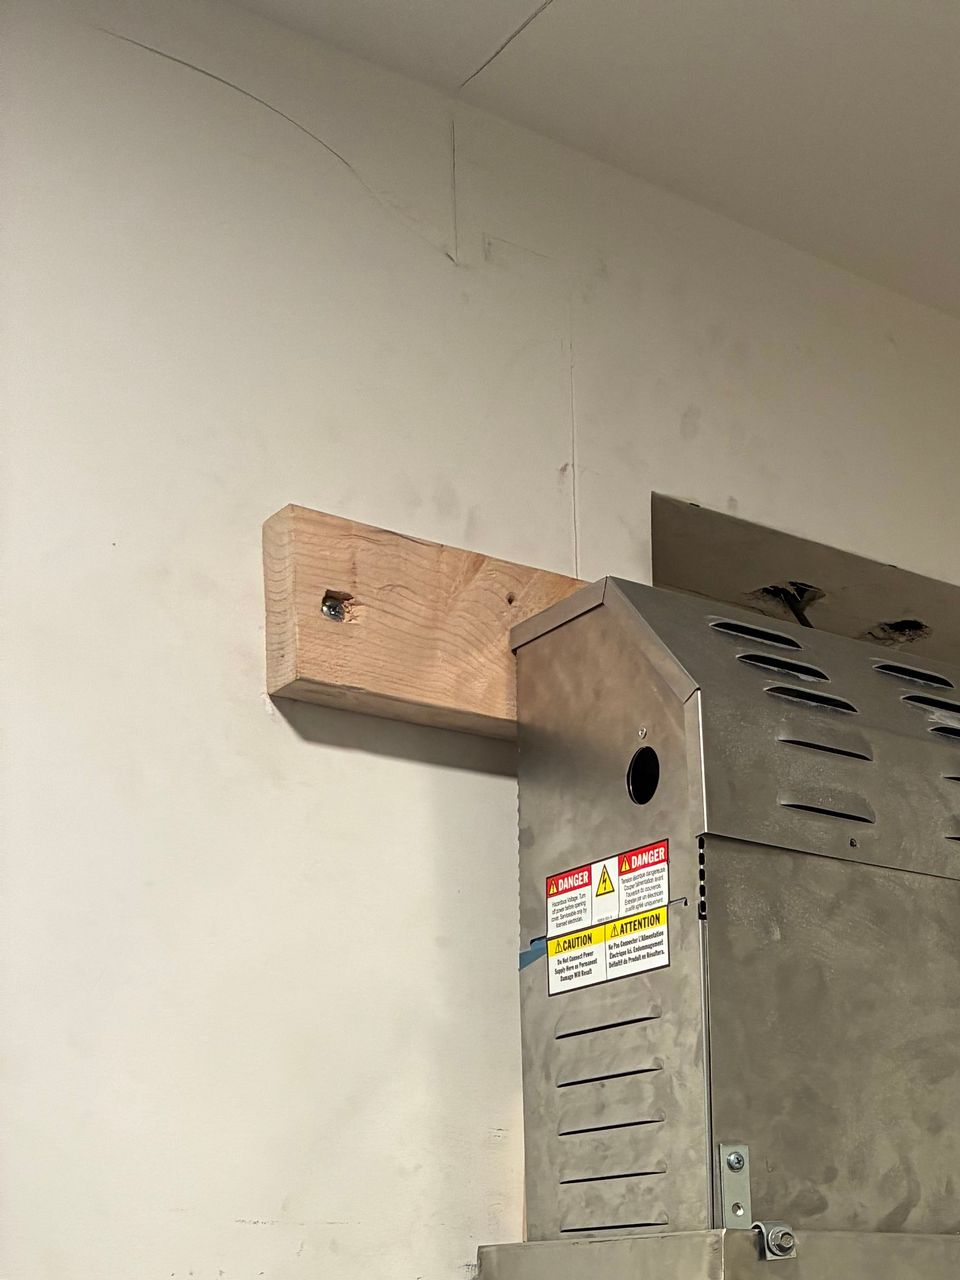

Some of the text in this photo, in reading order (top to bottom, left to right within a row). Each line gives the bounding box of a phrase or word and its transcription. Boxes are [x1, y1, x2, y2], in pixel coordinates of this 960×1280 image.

[631, 847, 665, 869] DANGER
[558, 871, 589, 892] DANGER
[619, 913, 661, 935] ATTENTION
[562, 933, 592, 951] CAUTION
[620, 938, 639, 947] Connecter
[633, 939, 664, 953] Endommagement
[569, 953, 583, 962] Connect
[554, 967, 565, 975] Supply
[579, 958, 598, 968] Permanent
[560, 974, 574, 982] Damage
